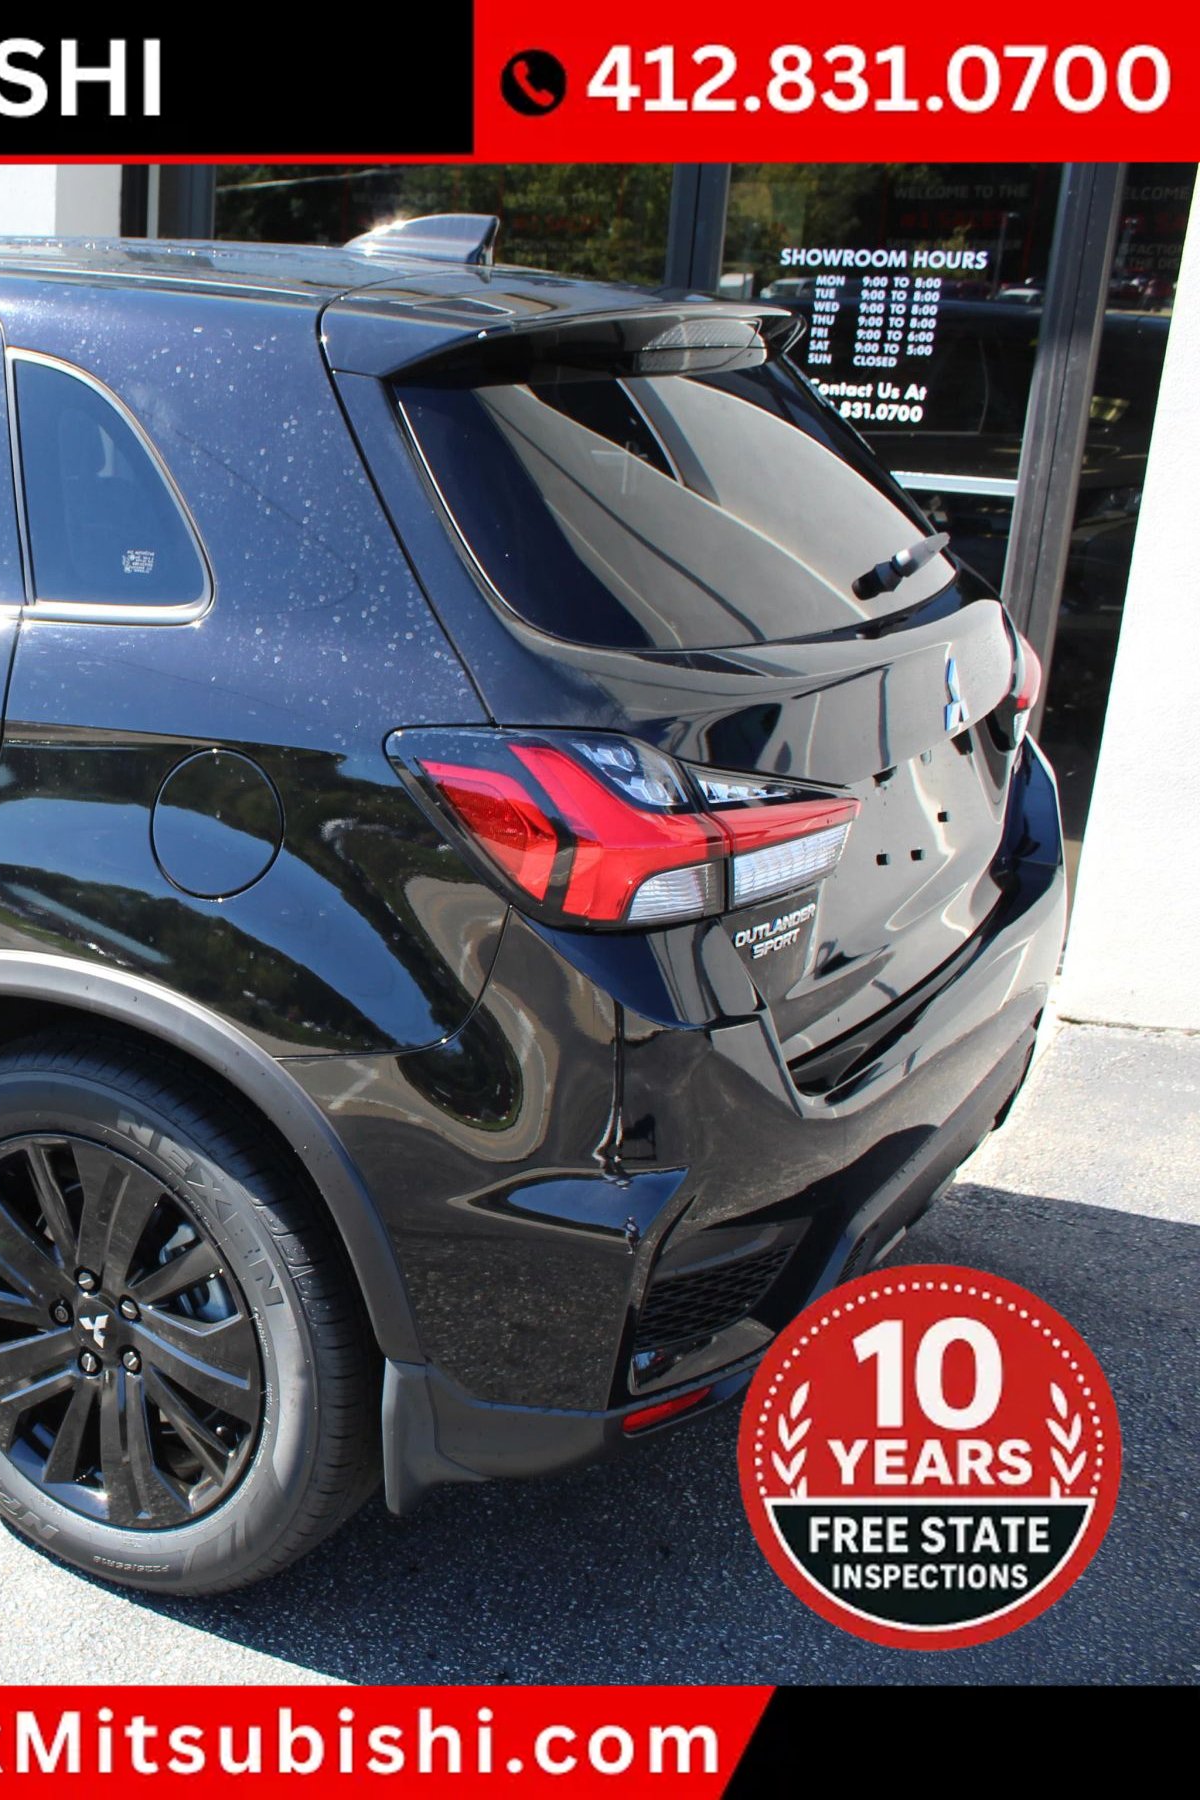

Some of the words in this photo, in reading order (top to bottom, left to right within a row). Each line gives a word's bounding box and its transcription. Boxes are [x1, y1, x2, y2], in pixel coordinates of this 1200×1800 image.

[780, 248, 907, 269] SHOWROOM
[912, 251, 989, 270] HOURS
[816, 275, 846, 287] MON
[862, 276, 888, 288] 9:00
[894, 277, 910, 288] TO
[914, 277, 941, 288] 8:00
[814, 288, 836, 300] TUE
[860, 289, 886, 301] 9:00
[891, 290, 907, 302] TO
[913, 291, 940, 303] 8:00
[813, 301, 840, 313] WED
[859, 303, 885, 314] 9:00
[890, 303, 906, 315] TO
[911, 304, 938, 316] 8:00
[812, 314, 835, 326] THU
[857, 316, 883, 328] 9:00
[889, 317, 905, 328] TO
[909, 318, 936, 329] 8:00
[810, 327, 828, 338] FRI
[856, 329, 881, 341] 9:00
[886, 330, 903, 341] TO
[907, 331, 934, 343] 6:00
[809, 340, 830, 351] SAT
[854, 342, 880, 354] 9:00
[883, 343, 900, 354] TO
[906, 344, 933, 356] 5:00
[807, 353, 832, 365] SUN
[852, 355, 898, 368] CLOSED
[877, 382, 901, 400] Us
[904, 384, 928, 401] At
[732, 902, 817, 948] OUTLANDER
[751, 927, 801, 960] SPORT
[116, 1109, 285, 1307] NEXEN
